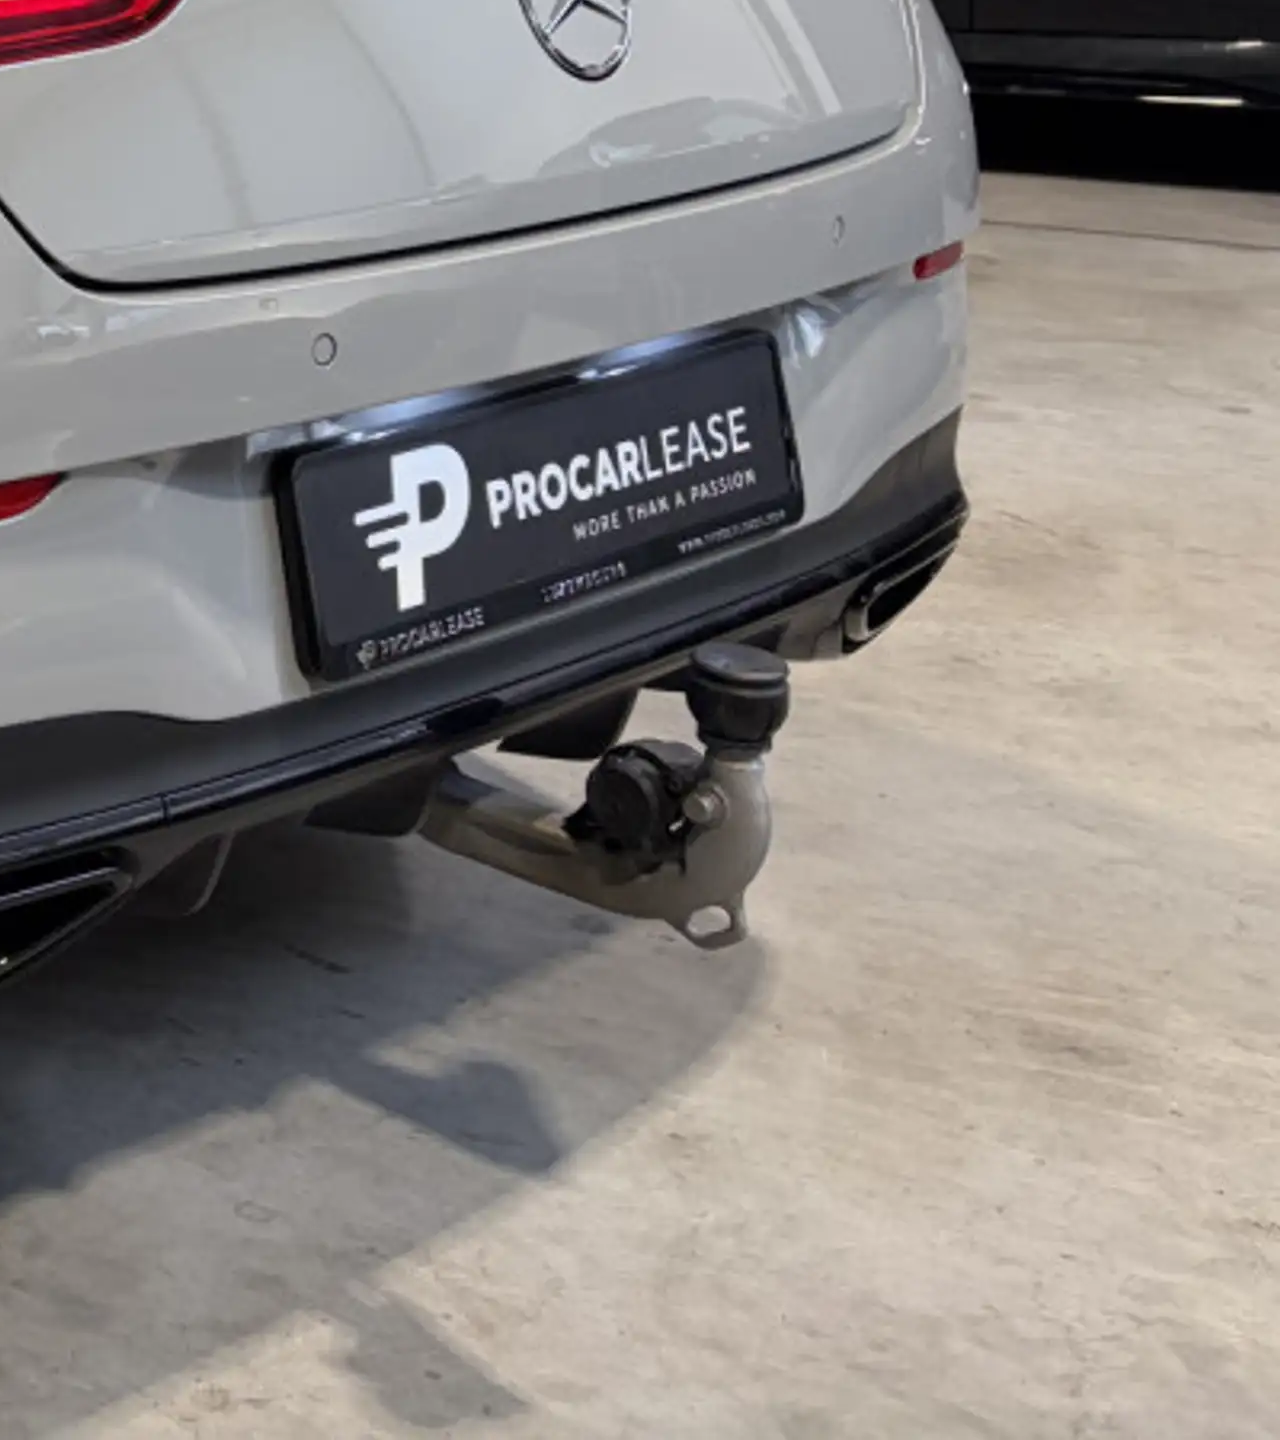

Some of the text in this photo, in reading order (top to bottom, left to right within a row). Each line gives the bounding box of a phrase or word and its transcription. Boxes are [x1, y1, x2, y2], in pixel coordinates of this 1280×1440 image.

[486, 406, 751, 530] PROCARLEASE
[573, 467, 757, 541] MORE THAN A PASSION
